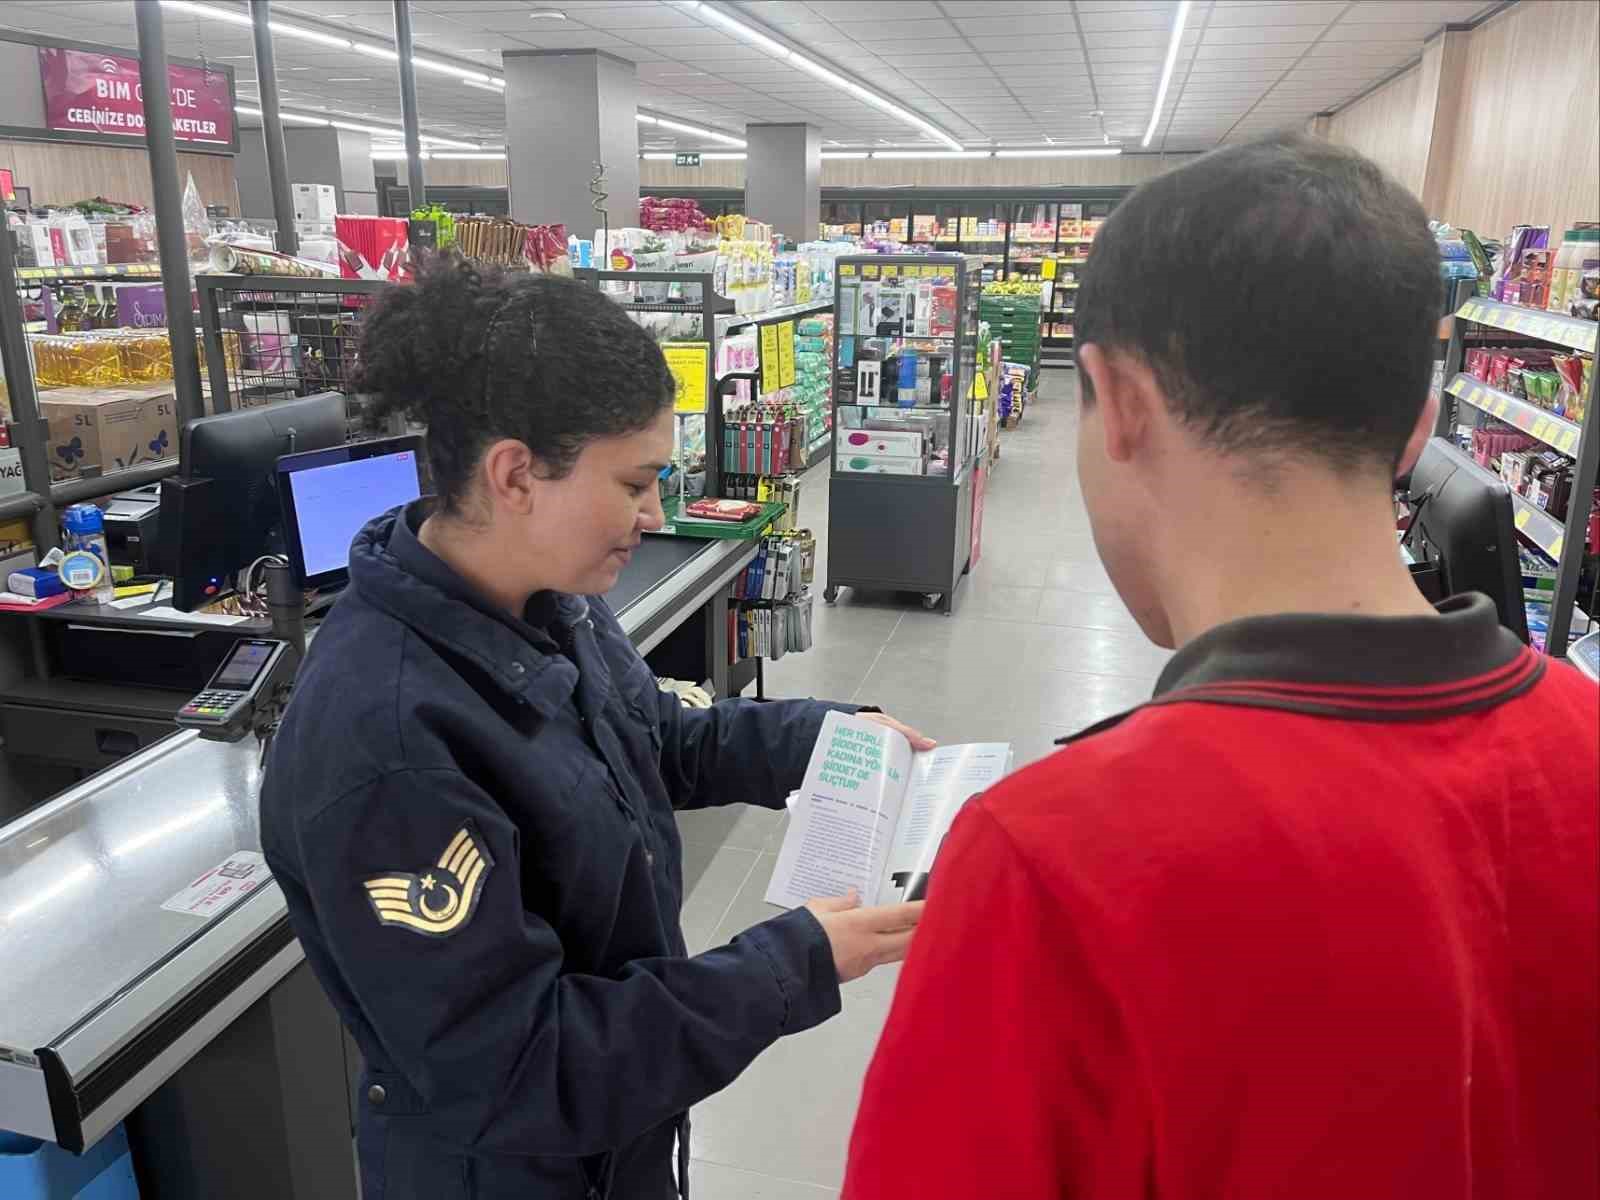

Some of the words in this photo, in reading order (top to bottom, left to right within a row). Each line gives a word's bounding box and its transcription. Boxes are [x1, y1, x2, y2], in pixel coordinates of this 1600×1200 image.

[95, 79, 131, 101] BIM
[67, 105, 125, 127] CEBİNİZE
[834, 724, 855, 738] HER
[826, 748, 864, 766] KADINA
